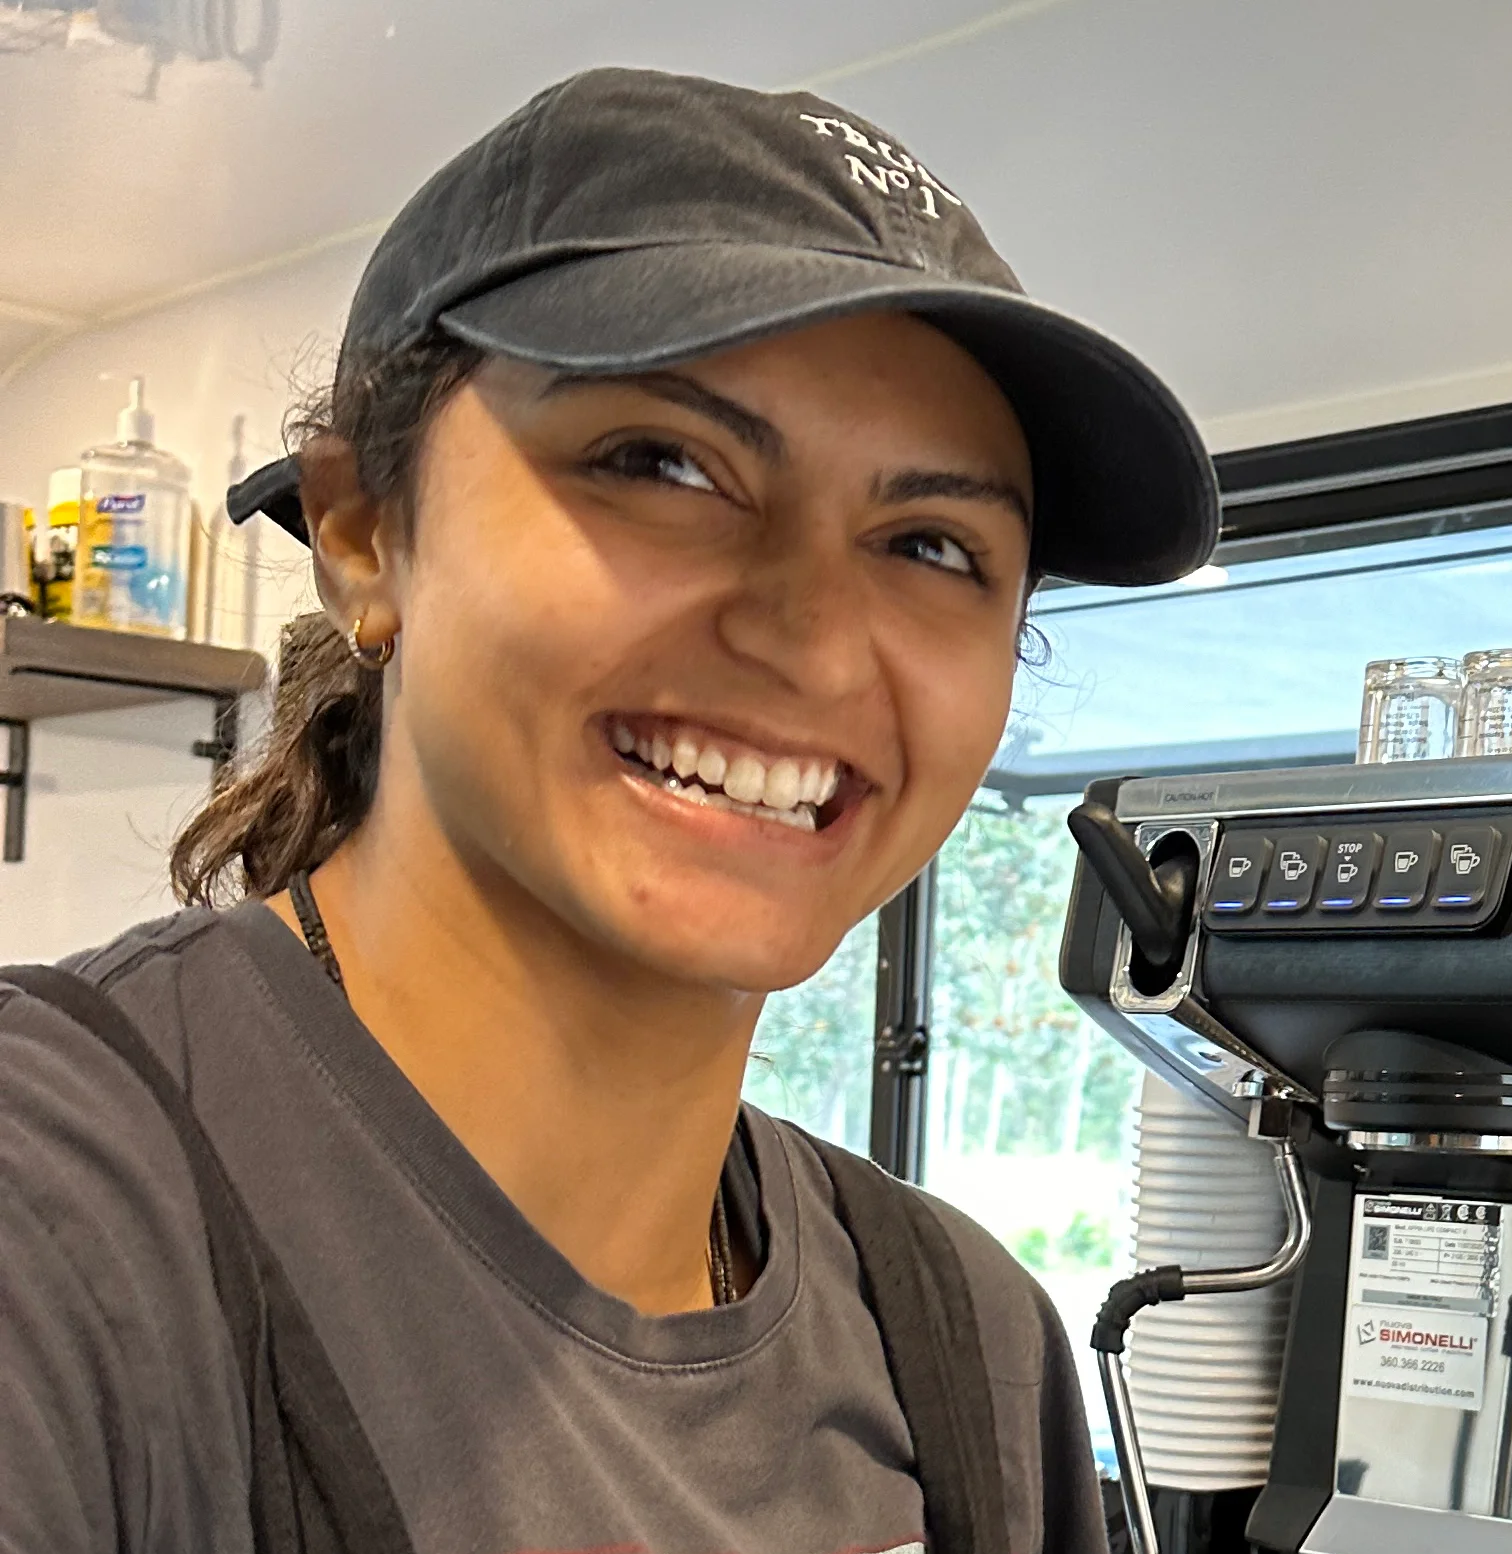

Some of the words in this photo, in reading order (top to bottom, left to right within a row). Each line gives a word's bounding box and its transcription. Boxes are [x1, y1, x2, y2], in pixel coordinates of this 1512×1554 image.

[1337, 842, 1363, 855] STOP
[1379, 1319, 1412, 1329] nuova
[1379, 1328, 1474, 1350] SIMONELLI
[1380, 1355, 1445, 1373] 360.366.2226
[1353, 1378, 1474, 1398] www.nuovadistribution.com
